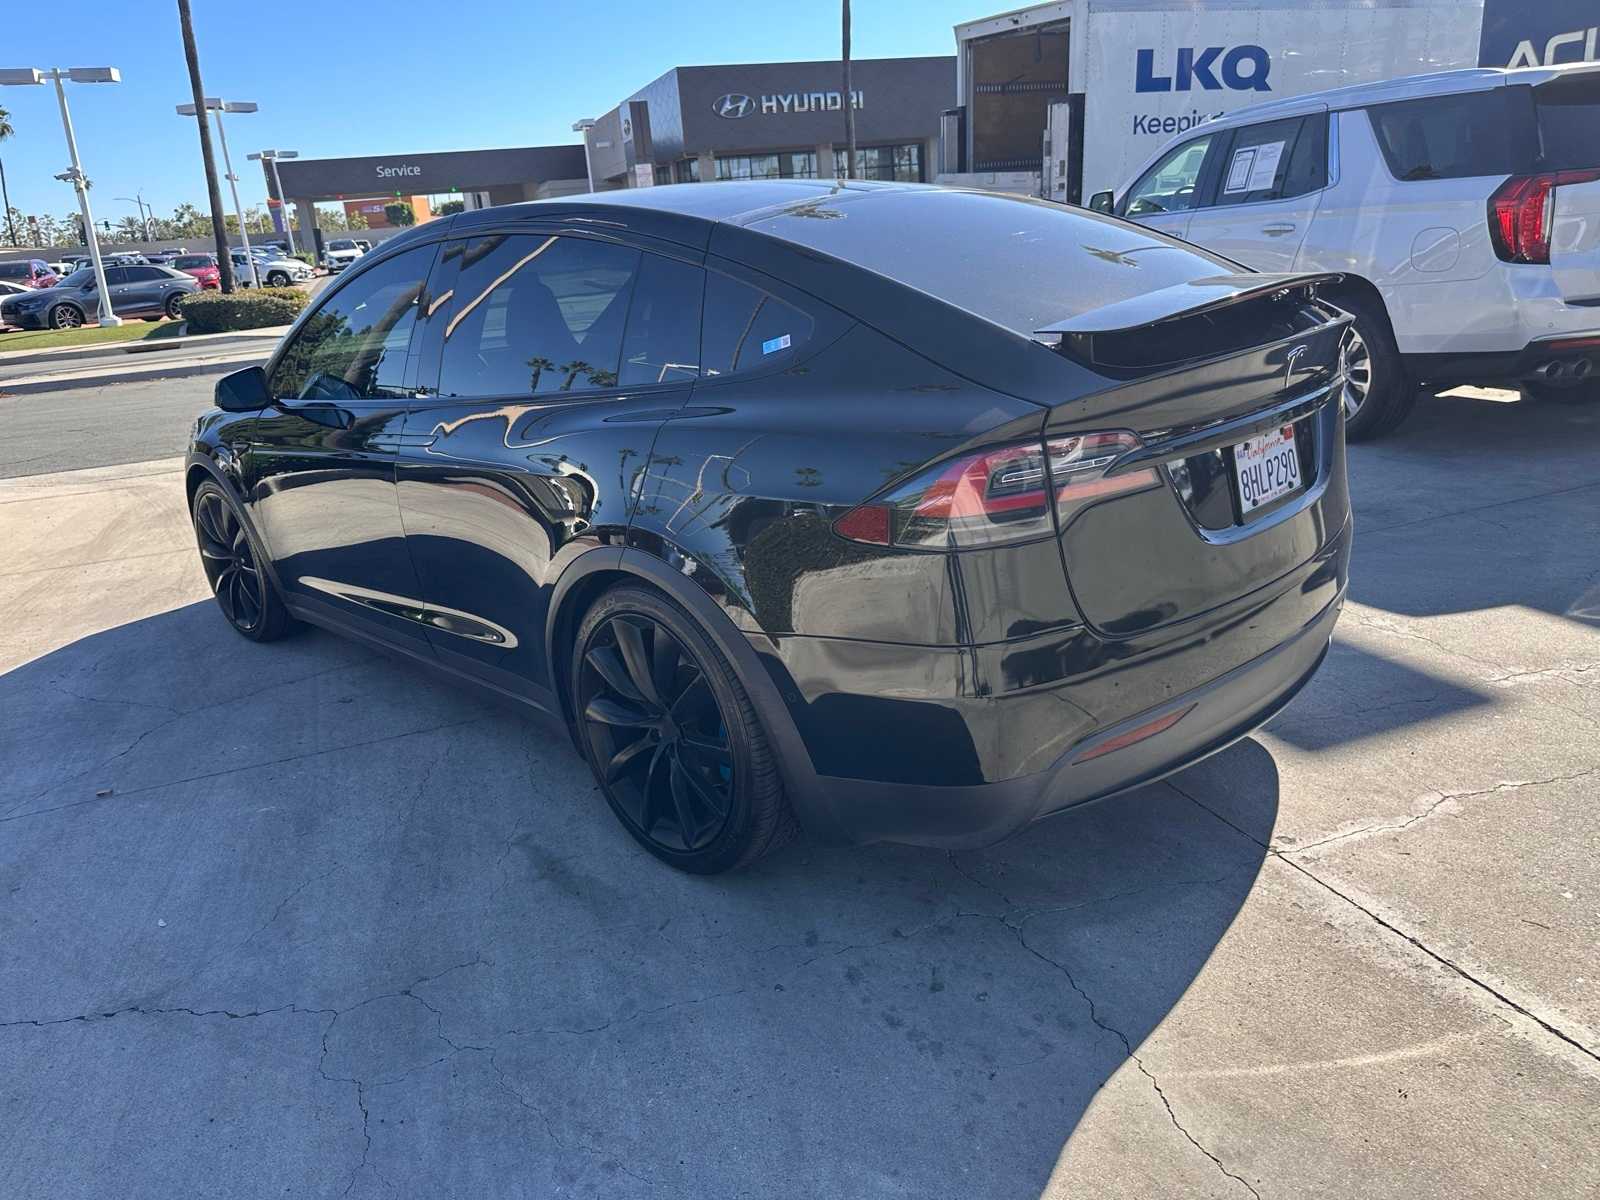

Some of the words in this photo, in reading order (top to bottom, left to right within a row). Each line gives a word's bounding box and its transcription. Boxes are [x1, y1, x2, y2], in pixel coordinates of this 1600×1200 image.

[1134, 44, 1272, 93] LKQ
[376, 164, 421, 178] Service
[1241, 448, 1297, 501] 8HLP290
